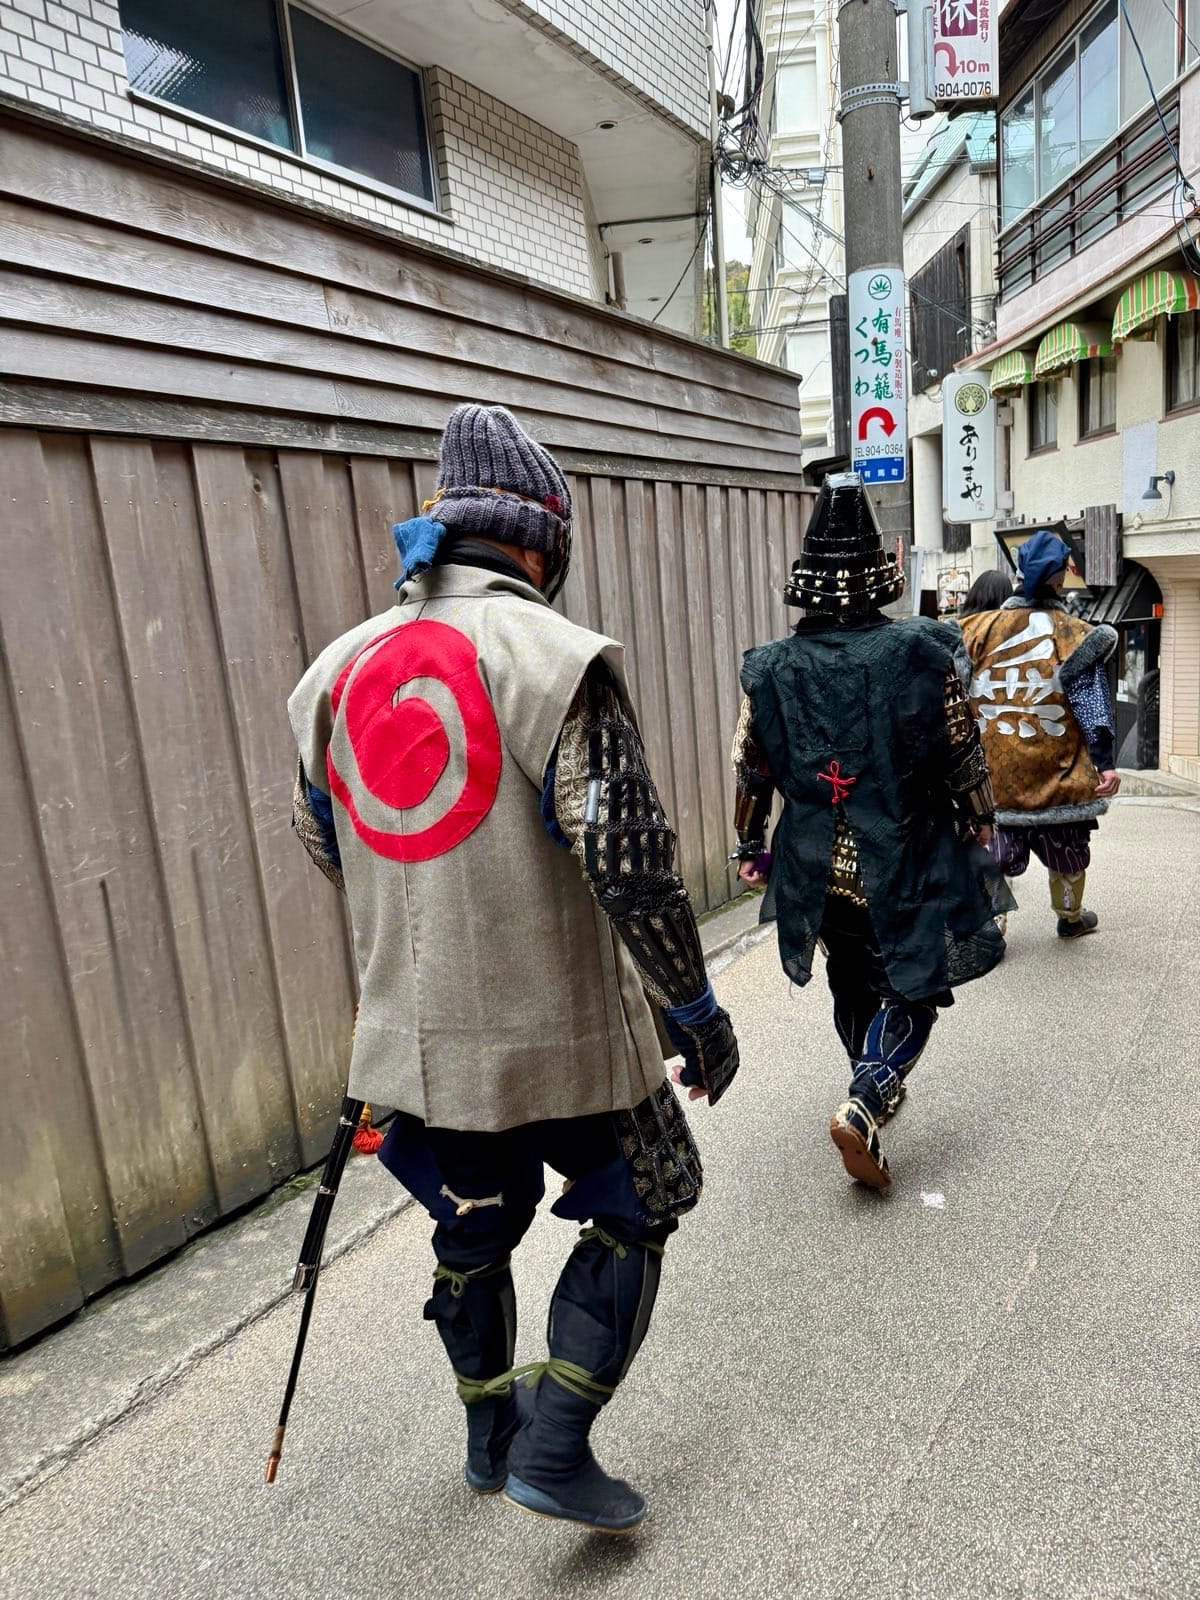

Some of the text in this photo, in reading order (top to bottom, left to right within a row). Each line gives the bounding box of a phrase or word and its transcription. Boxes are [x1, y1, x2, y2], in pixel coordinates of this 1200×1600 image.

[940, 0, 977, 30] 休
[960, 60, 990, 73] 10m
[854, 316, 870, 397] くつわ
[871, 307, 894, 401] 有馬籠
[959, 422, 983, 502] ありまや
